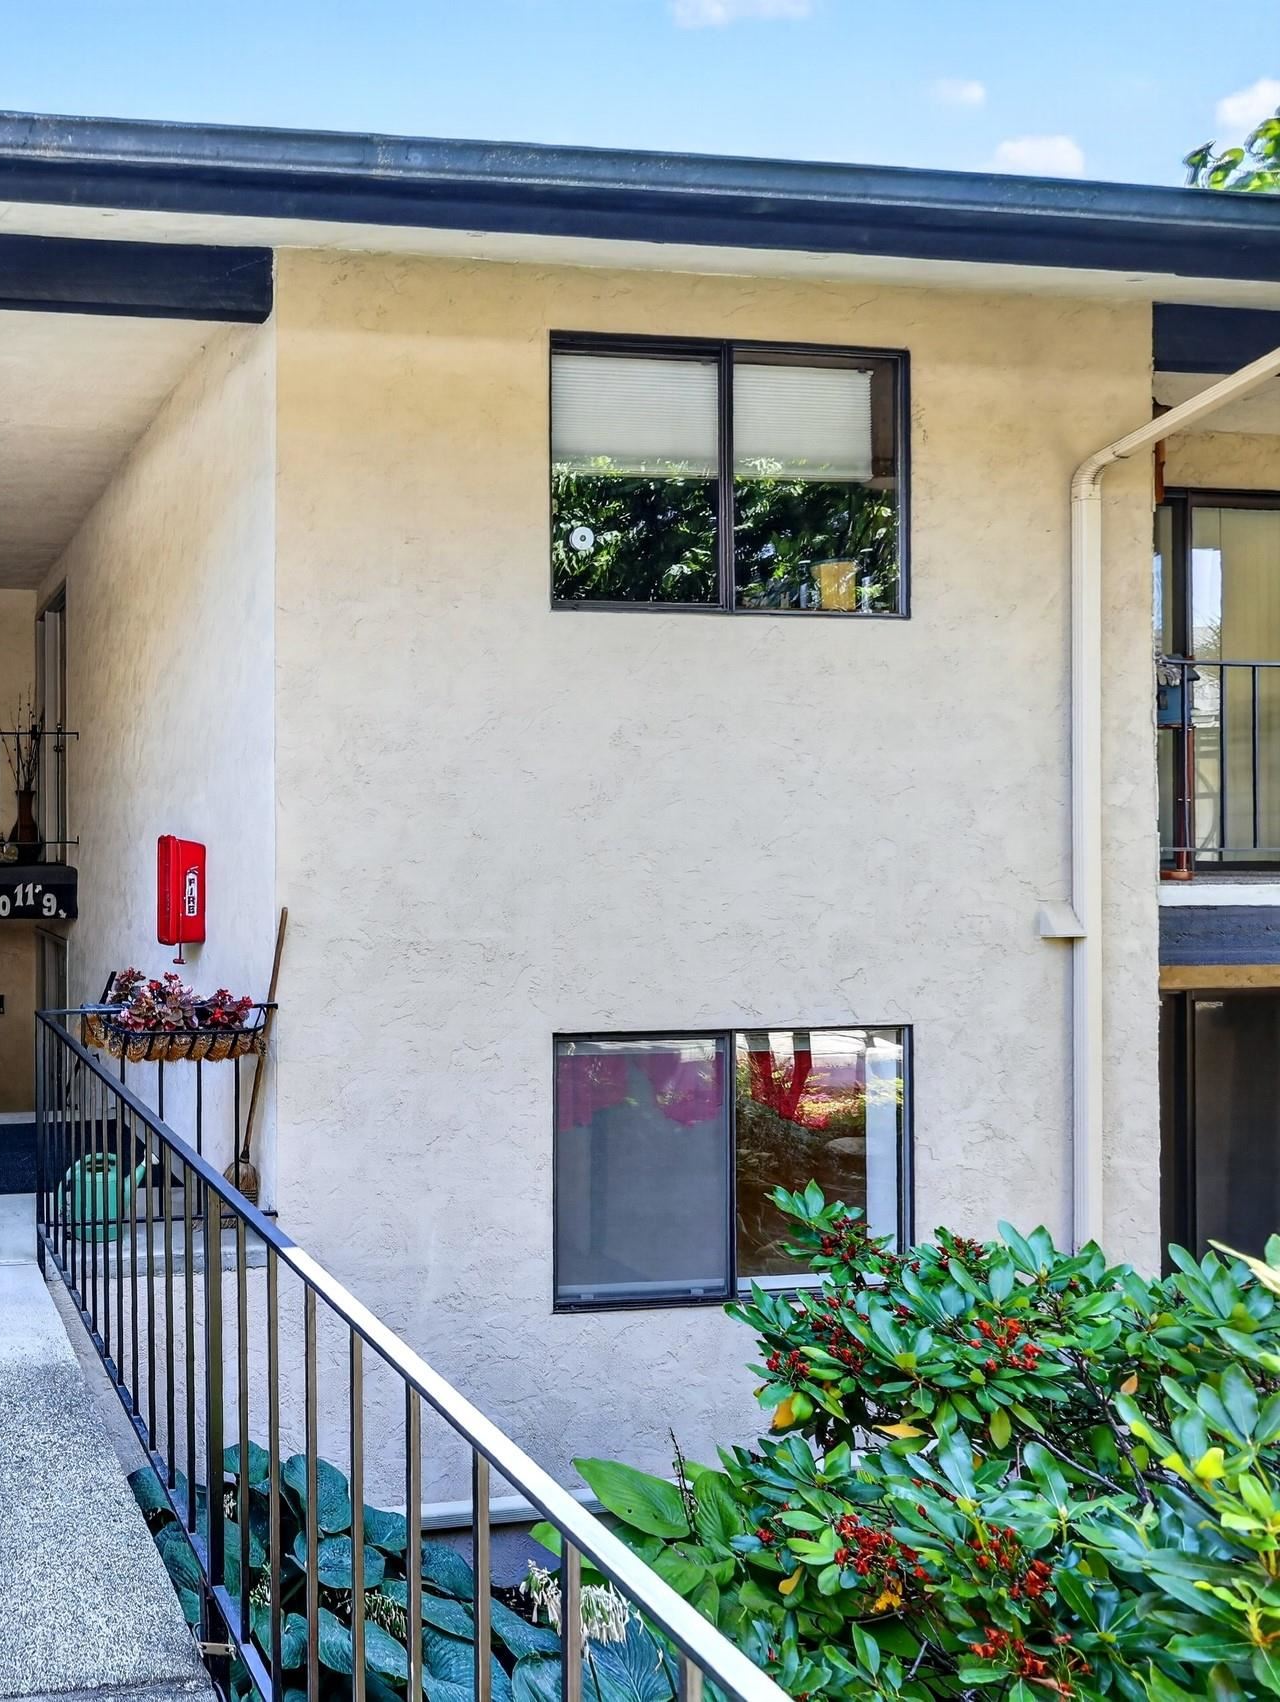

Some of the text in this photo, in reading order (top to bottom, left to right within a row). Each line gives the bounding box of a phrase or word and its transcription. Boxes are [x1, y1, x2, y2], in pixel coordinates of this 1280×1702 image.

[14, 883, 35, 907] 11
[42, 893, 57, 917] 9
[187, 877, 196, 915] FIRE
